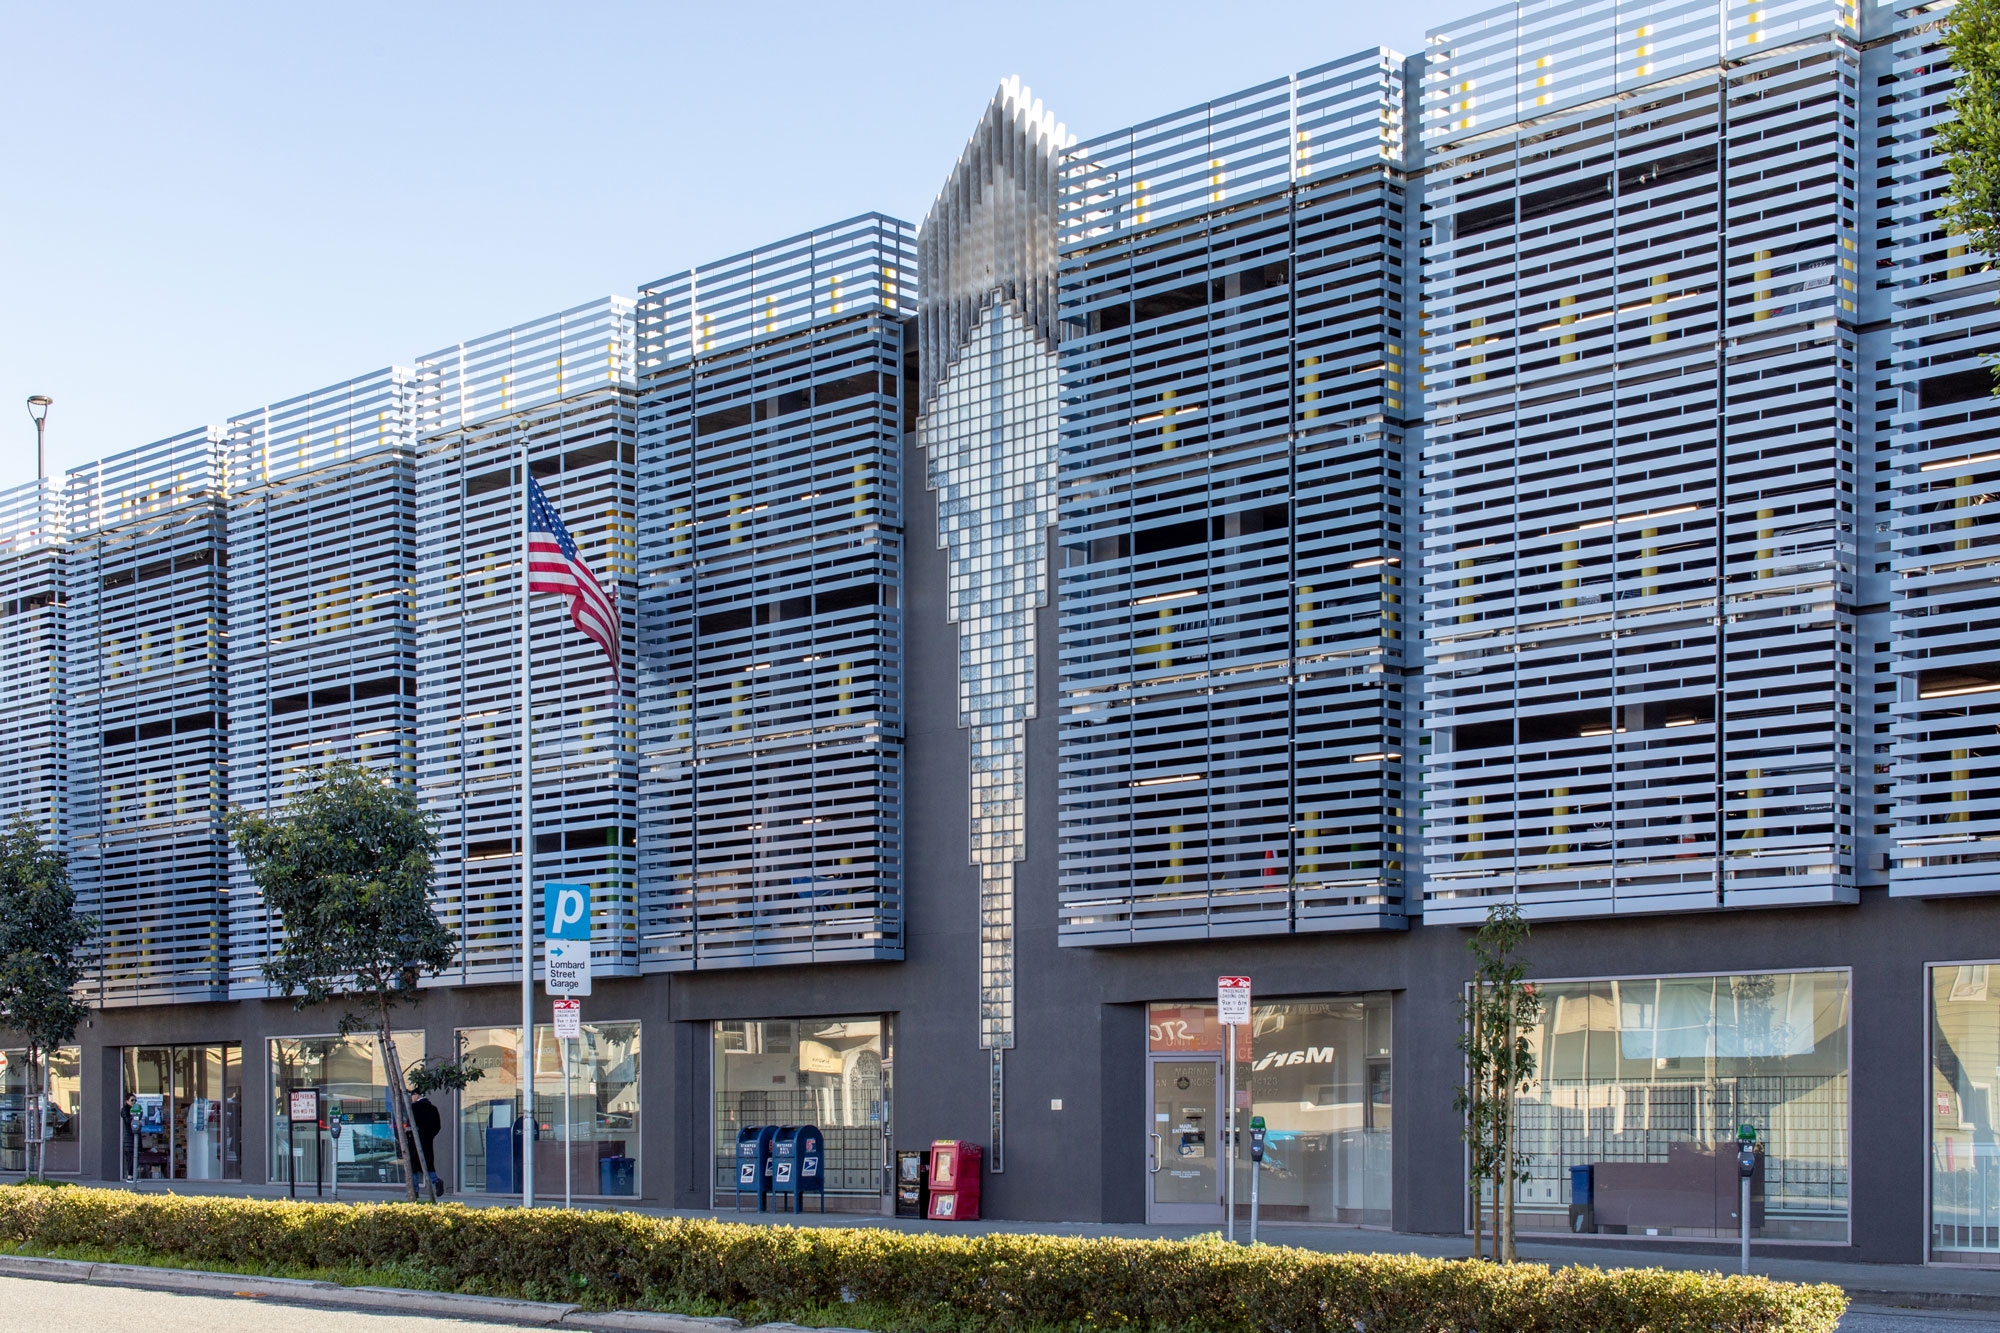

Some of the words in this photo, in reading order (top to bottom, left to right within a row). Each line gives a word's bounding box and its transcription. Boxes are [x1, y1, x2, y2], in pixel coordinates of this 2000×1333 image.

[550, 960, 585, 969] Lombard
[550, 969, 576, 979] Street
[550, 979, 579, 990] Garage
[1166, 1032, 1209, 1047] UNITED
[1175, 1067, 1208, 1076] MARINA
